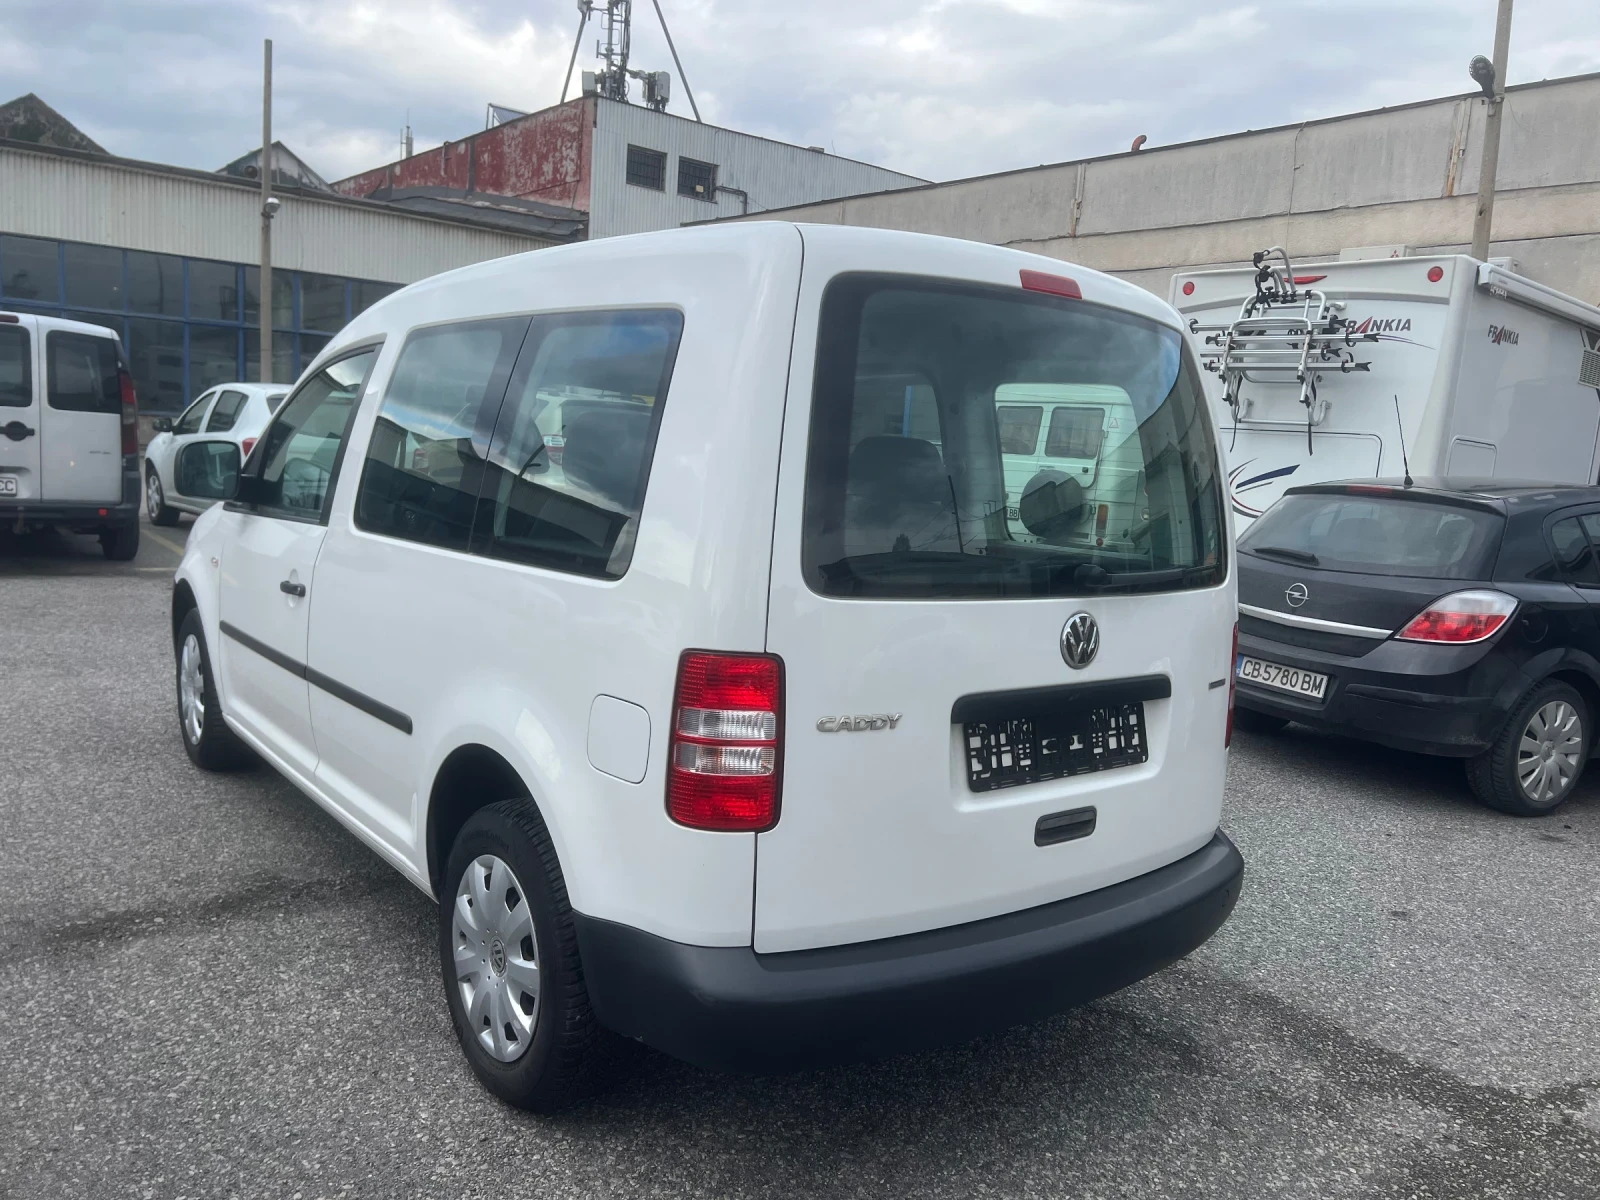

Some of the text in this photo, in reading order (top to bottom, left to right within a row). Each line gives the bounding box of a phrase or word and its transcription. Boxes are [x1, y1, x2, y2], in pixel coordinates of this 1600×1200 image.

[1345, 316, 1411, 334] RANKIA
[1487, 324, 1520, 346] FRANKIA
[816, 713, 903, 732] CADDY
